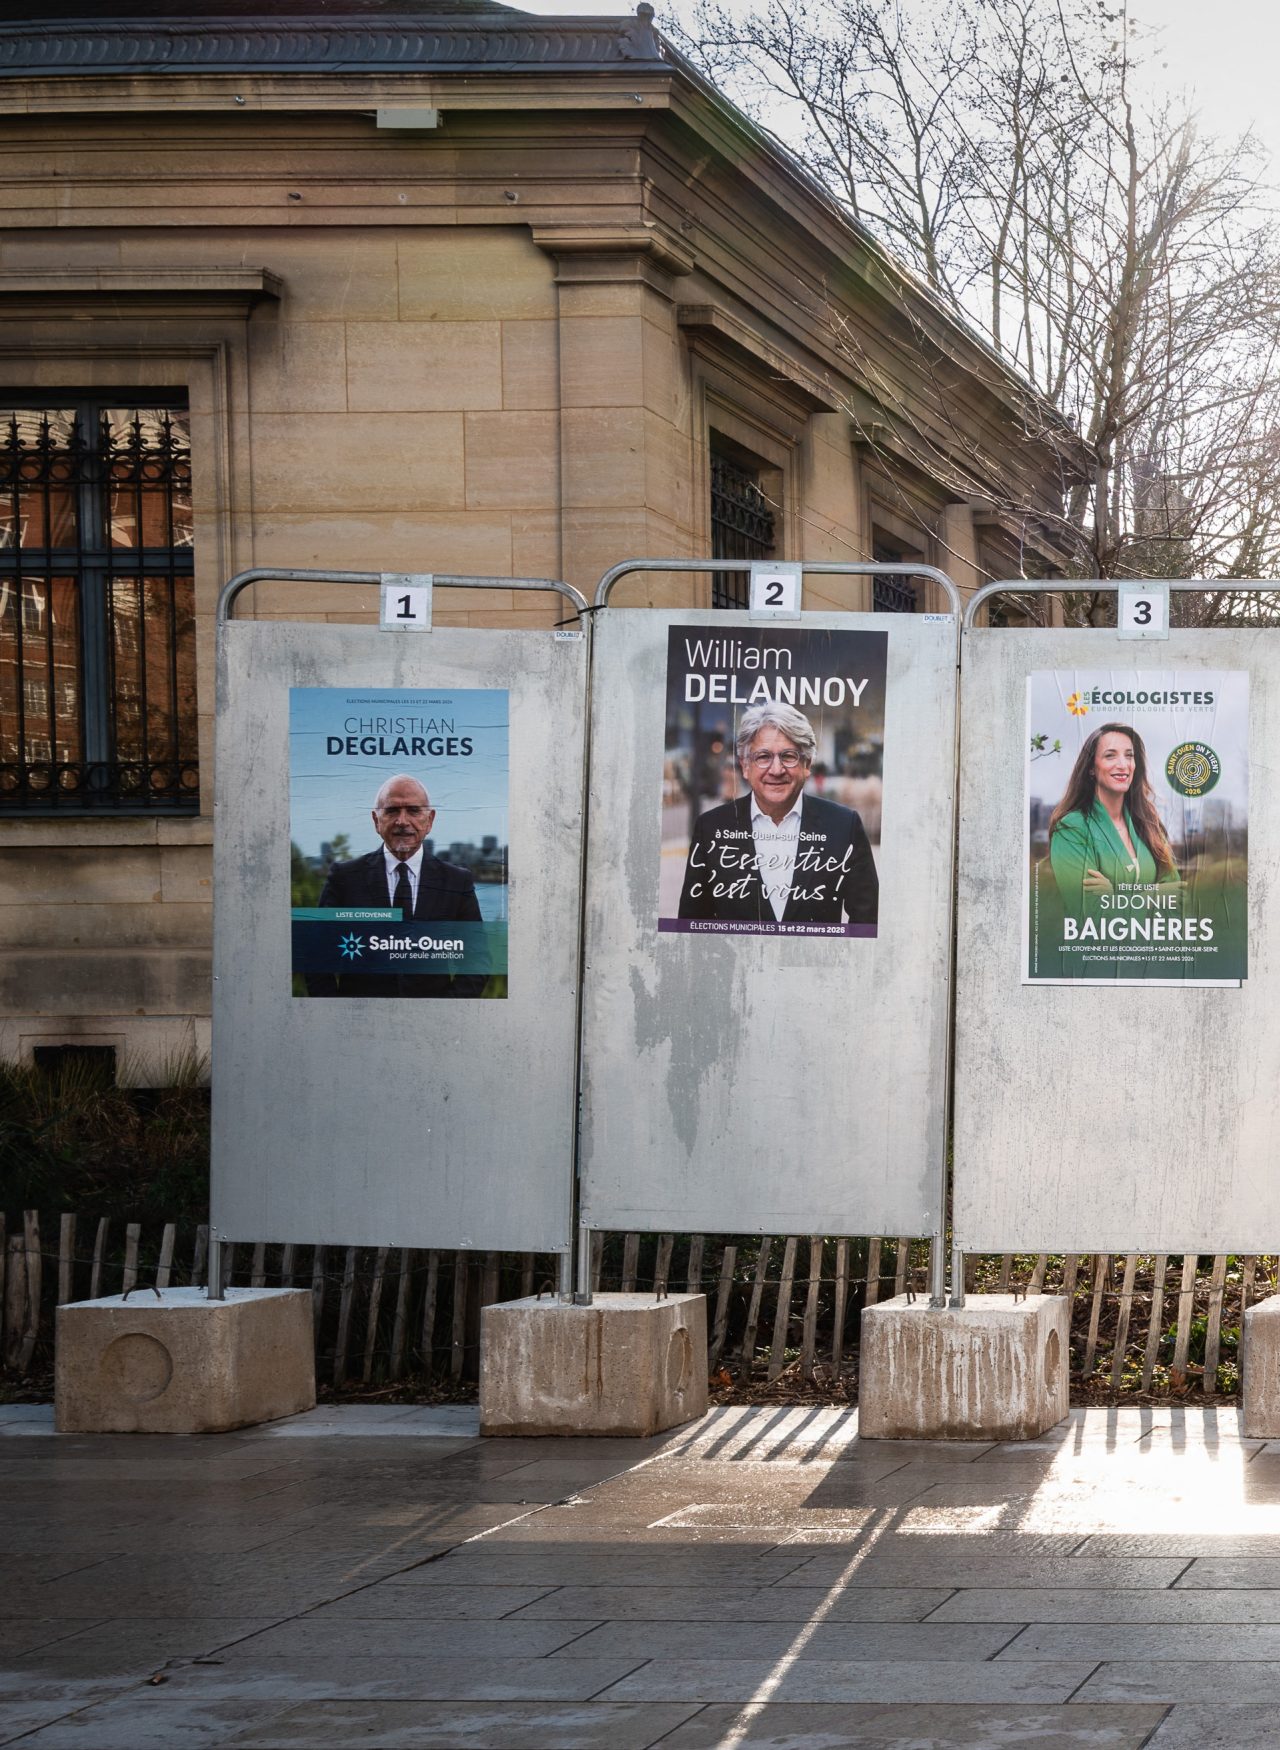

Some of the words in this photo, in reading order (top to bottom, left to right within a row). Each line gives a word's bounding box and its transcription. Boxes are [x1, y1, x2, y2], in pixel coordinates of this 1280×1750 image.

[765, 582, 784, 606] 2
[396, 594, 416, 620] 1
[1133, 600, 1152, 625] 3
[685, 638, 792, 670] William
[684, 673, 869, 707] DELANNOY
[1091, 686, 1214, 704] ÉCOLOGISTES
[344, 718, 454, 734] CHRISTIAN
[326, 736, 473, 756] DEGLARGES
[1196, 744, 1206, 753] ON
[1208, 754, 1219, 774] TIENT
[715, 830, 722, 839] à
[723, 830, 827, 842] Saint-Ouen-sur-Seine
[690, 840, 854, 872] L'Essentiel
[690, 870, 758, 899] c'est
[762, 882, 826, 900] vous
[1100, 894, 1177, 910] SIDONIE
[690, 921, 728, 930] ÉLECTIONS
[730, 923, 775, 932] MUNICIPALES
[1064, 912, 1214, 941] BAIGNÈRES
[369, 935, 464, 951] Saint-Ouen
[389, 952, 407, 960] pour
